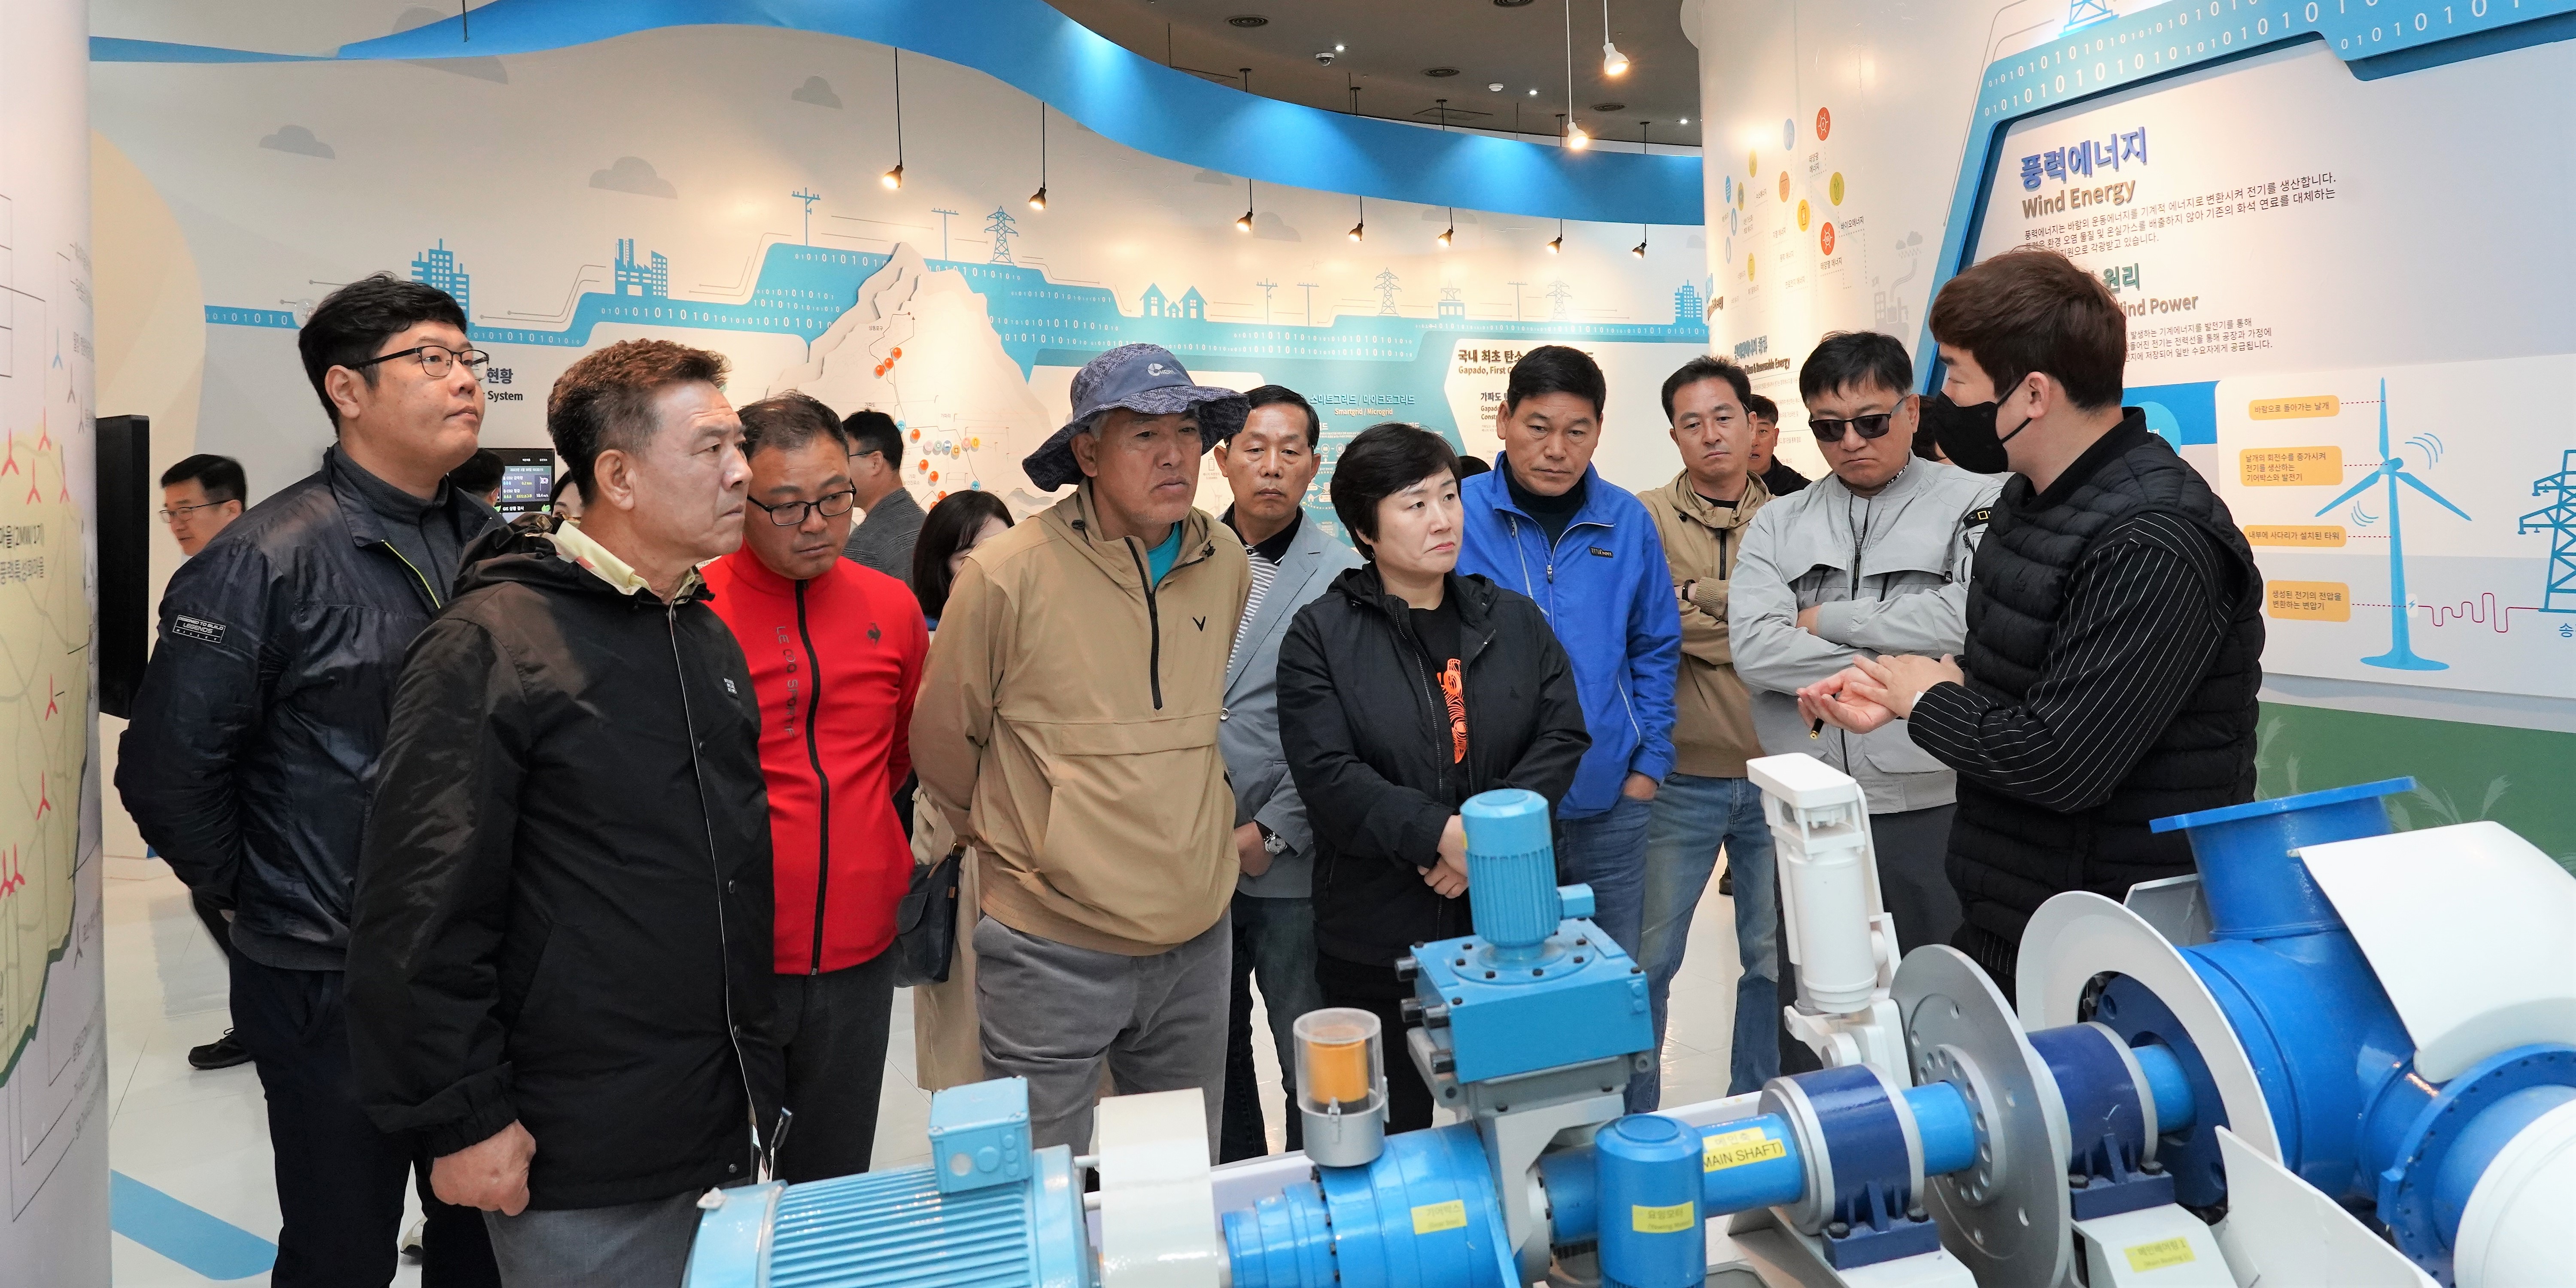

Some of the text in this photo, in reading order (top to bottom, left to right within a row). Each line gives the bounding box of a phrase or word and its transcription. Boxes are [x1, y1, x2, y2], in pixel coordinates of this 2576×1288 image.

[2020, 127, 2146, 191] 풍력에너지
[2022, 180, 2136, 219] Wind Energy
[2025, 172, 2336, 240] 풍력에너지는 바람의 운동에너지를 기계적 에너지로 변환시켜 전기를 생산합니다.
[2047, 237, 2061, 249] 환경
[2063, 234, 2078, 245] 오염
[2080, 230, 2094, 242] 물질
[2097, 228, 2104, 238] 및
[2107, 220, 2146, 237] 온실가스를
[2149, 213, 2183, 228] 배출하지
[2186, 210, 2204, 223] 않아
[2206, 205, 2233, 218] 기존의
[2237, 200, 2256, 214] 화석
[2260, 194, 2289, 210] 연료를
[2293, 187, 2336, 204] 대체하는
[2091, 239, 2121, 252] 각광받고
[2124, 233, 2159, 248] 있습니다.
[2103, 263, 2140, 294] 원리
[2119, 295, 2199, 318] ind Power
[2130, 317, 2252, 340] 발생하는 기계에너지를 발전기를 통해
[2152, 338, 2172, 348] 전기는
[2175, 334, 2203, 347] 전력선을
[2206, 331, 2220, 342] 통해
[2222, 330, 2245, 342] 공장과
[2248, 327, 2272, 338] 가정에
[1458, 349, 1524, 364] 국내 최초 탄소
[2146, 349, 2173, 360] 저장되어
[2175, 347, 2190, 357] 일반
[2192, 342, 2228, 355] 수요자에게
[2231, 340, 2272, 352] 공급됩니다.
[1458, 366, 1488, 376] Gapado,
[1490, 366, 1506, 375] First
[1775, 358, 1790, 371] Energy
[487, 368, 513, 384] 현황
[488, 390, 523, 402] System
[1310, 394, 1357, 405] 스마트그리드
[1364, 394, 1416, 405] 마이크로그리드
[1481, 392, 1502, 402] 가파도
[1335, 408, 1363, 417] Smartgrid
[1367, 408, 1393, 416] Microgrid
[2254, 401, 2329, 413] 바람으로 돌아가는 날개
[2246, 452, 2326, 462] 날개의 회전수를 증가시켜
[2246, 464, 2295, 472] 전기를 생산하는
[2247, 473, 2303, 482] 기어박스와 발전기
[2249, 531, 2340, 540] 내부에 사다리가 설치된 타워
[2273, 590, 2342, 601] 생성된 전기의 전압을
[2273, 601, 2324, 610] 변환하는 변압기
[183, 623, 213, 634] LEGENDS
[2559, 623, 2576, 638] 송
[776, 626, 799, 738] LE COQ SPORTIF
[1736, 1141, 1783, 1161] SHAFT)
